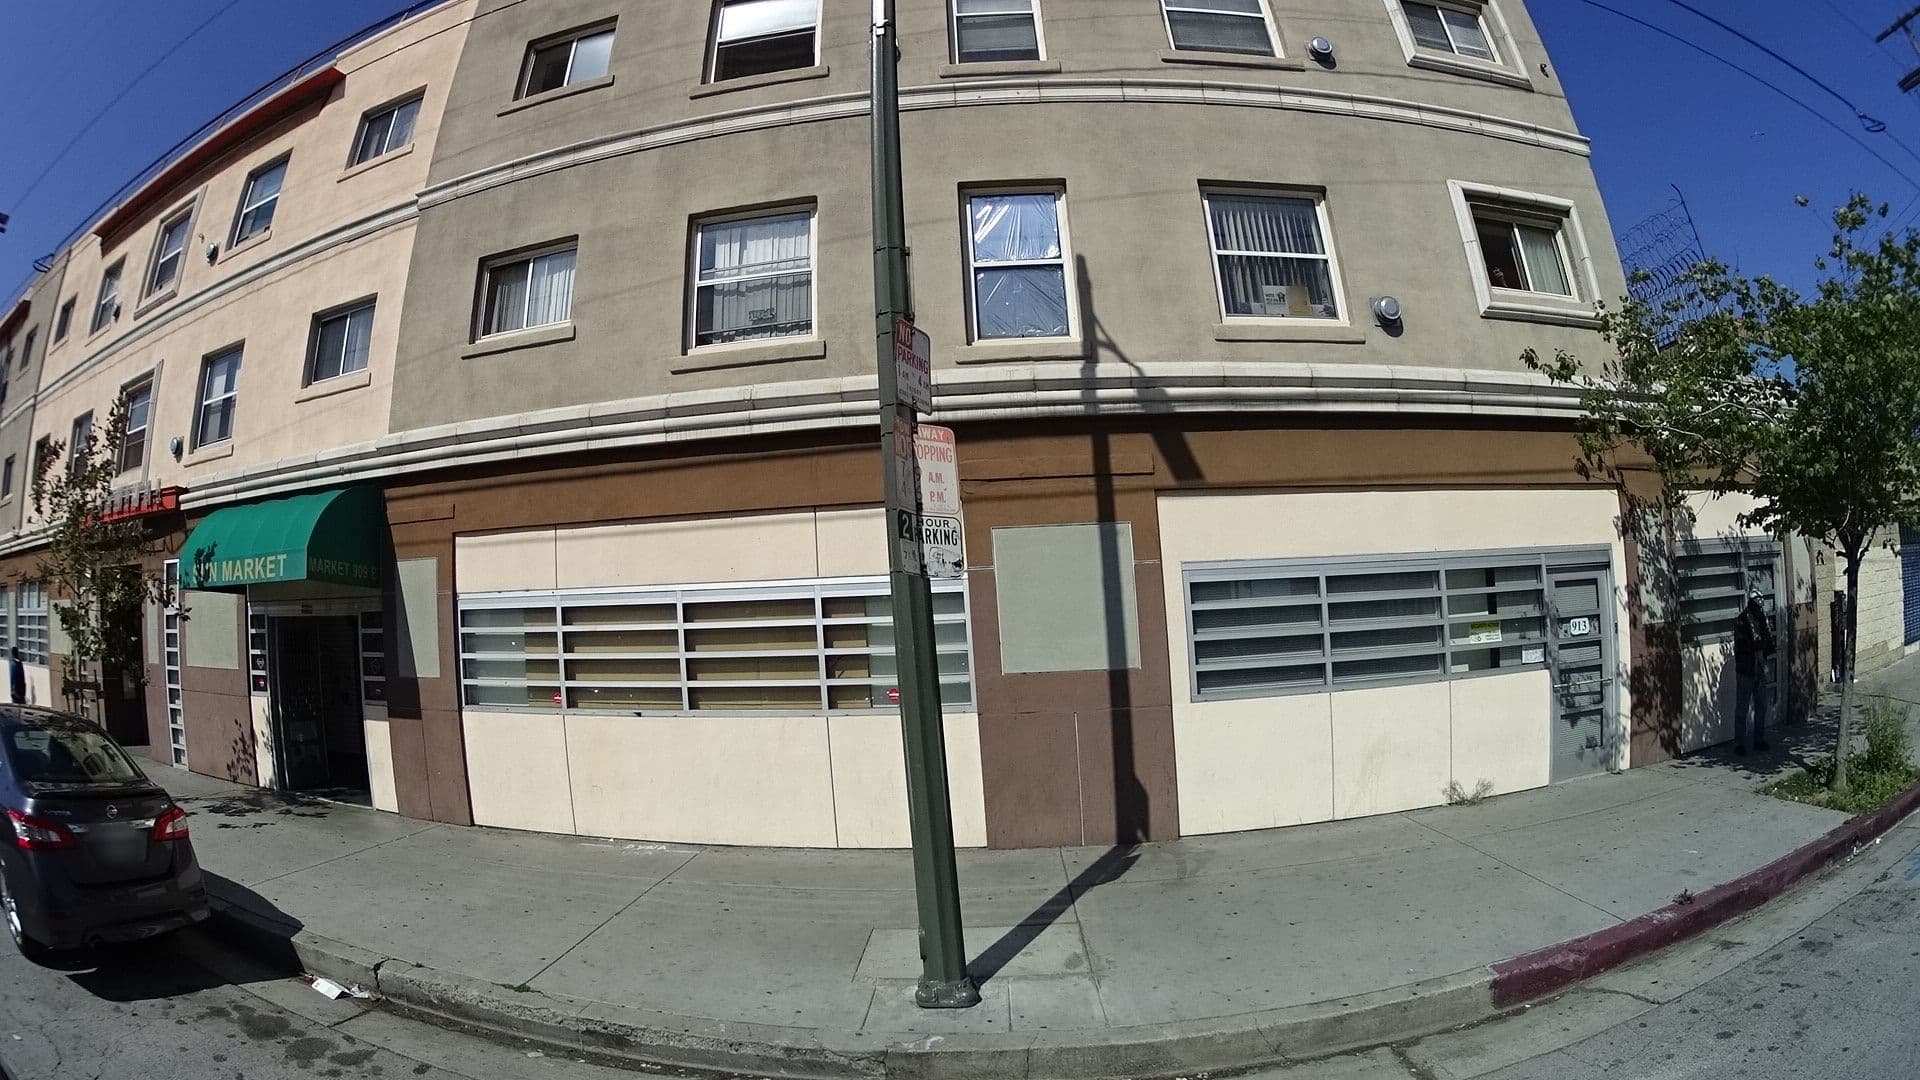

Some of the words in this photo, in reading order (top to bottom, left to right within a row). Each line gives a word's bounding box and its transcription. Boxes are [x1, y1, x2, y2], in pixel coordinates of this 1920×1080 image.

[899, 323, 911, 345] NO
[898, 346, 929, 375] PARKING
[914, 443, 952, 463] OPPING
[902, 513, 910, 538] 2
[222, 554, 287, 581] MARKET
[310, 557, 350, 577] MARKET
[1571, 620, 1587, 632] 913
